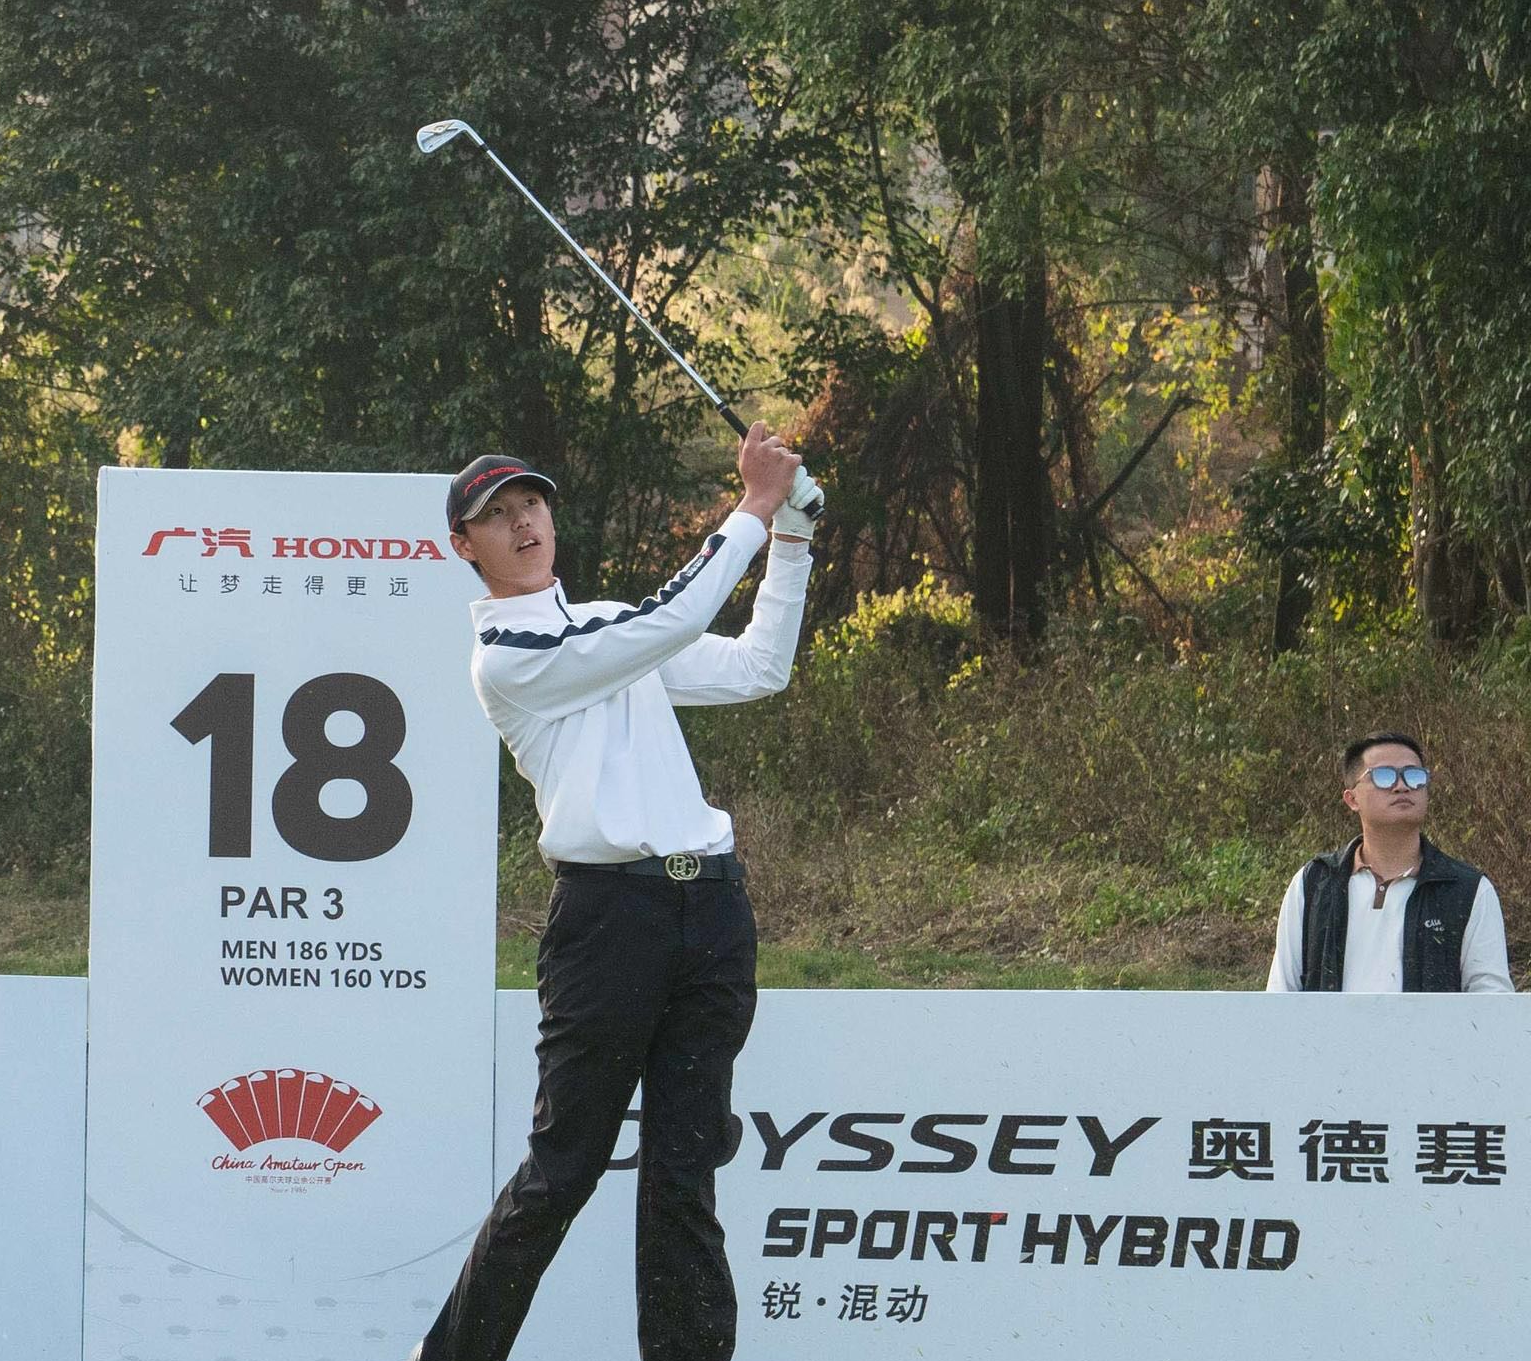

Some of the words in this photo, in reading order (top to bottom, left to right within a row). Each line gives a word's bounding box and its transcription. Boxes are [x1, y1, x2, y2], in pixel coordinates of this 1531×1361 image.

[141, 527, 255, 559] 广汽
[271, 536, 447, 561] HONDA
[178, 573, 409, 598] 让梦走得更远
[169, 672, 413, 862] 18
[220, 885, 309, 920] PAR
[322, 887, 344, 920] 3
[220, 939, 277, 960] MEN
[285, 940, 328, 961] 186
[335, 941, 383, 962] YDS
[220, 967, 321, 988] WOMEN
[329, 968, 372, 989] 160
[379, 969, 427, 990] YDS
[607, 1108, 1162, 1177] YSSEY
[1188, 1118, 1507, 1186] 奥德赛
[211, 1153, 257, 1171] China
[260, 1154, 321, 1171] Amateur
[323, 1158, 366, 1177] Open
[762, 1207, 1009, 1263] SPORT
[1019, 1213, 1301, 1271] HYBRID
